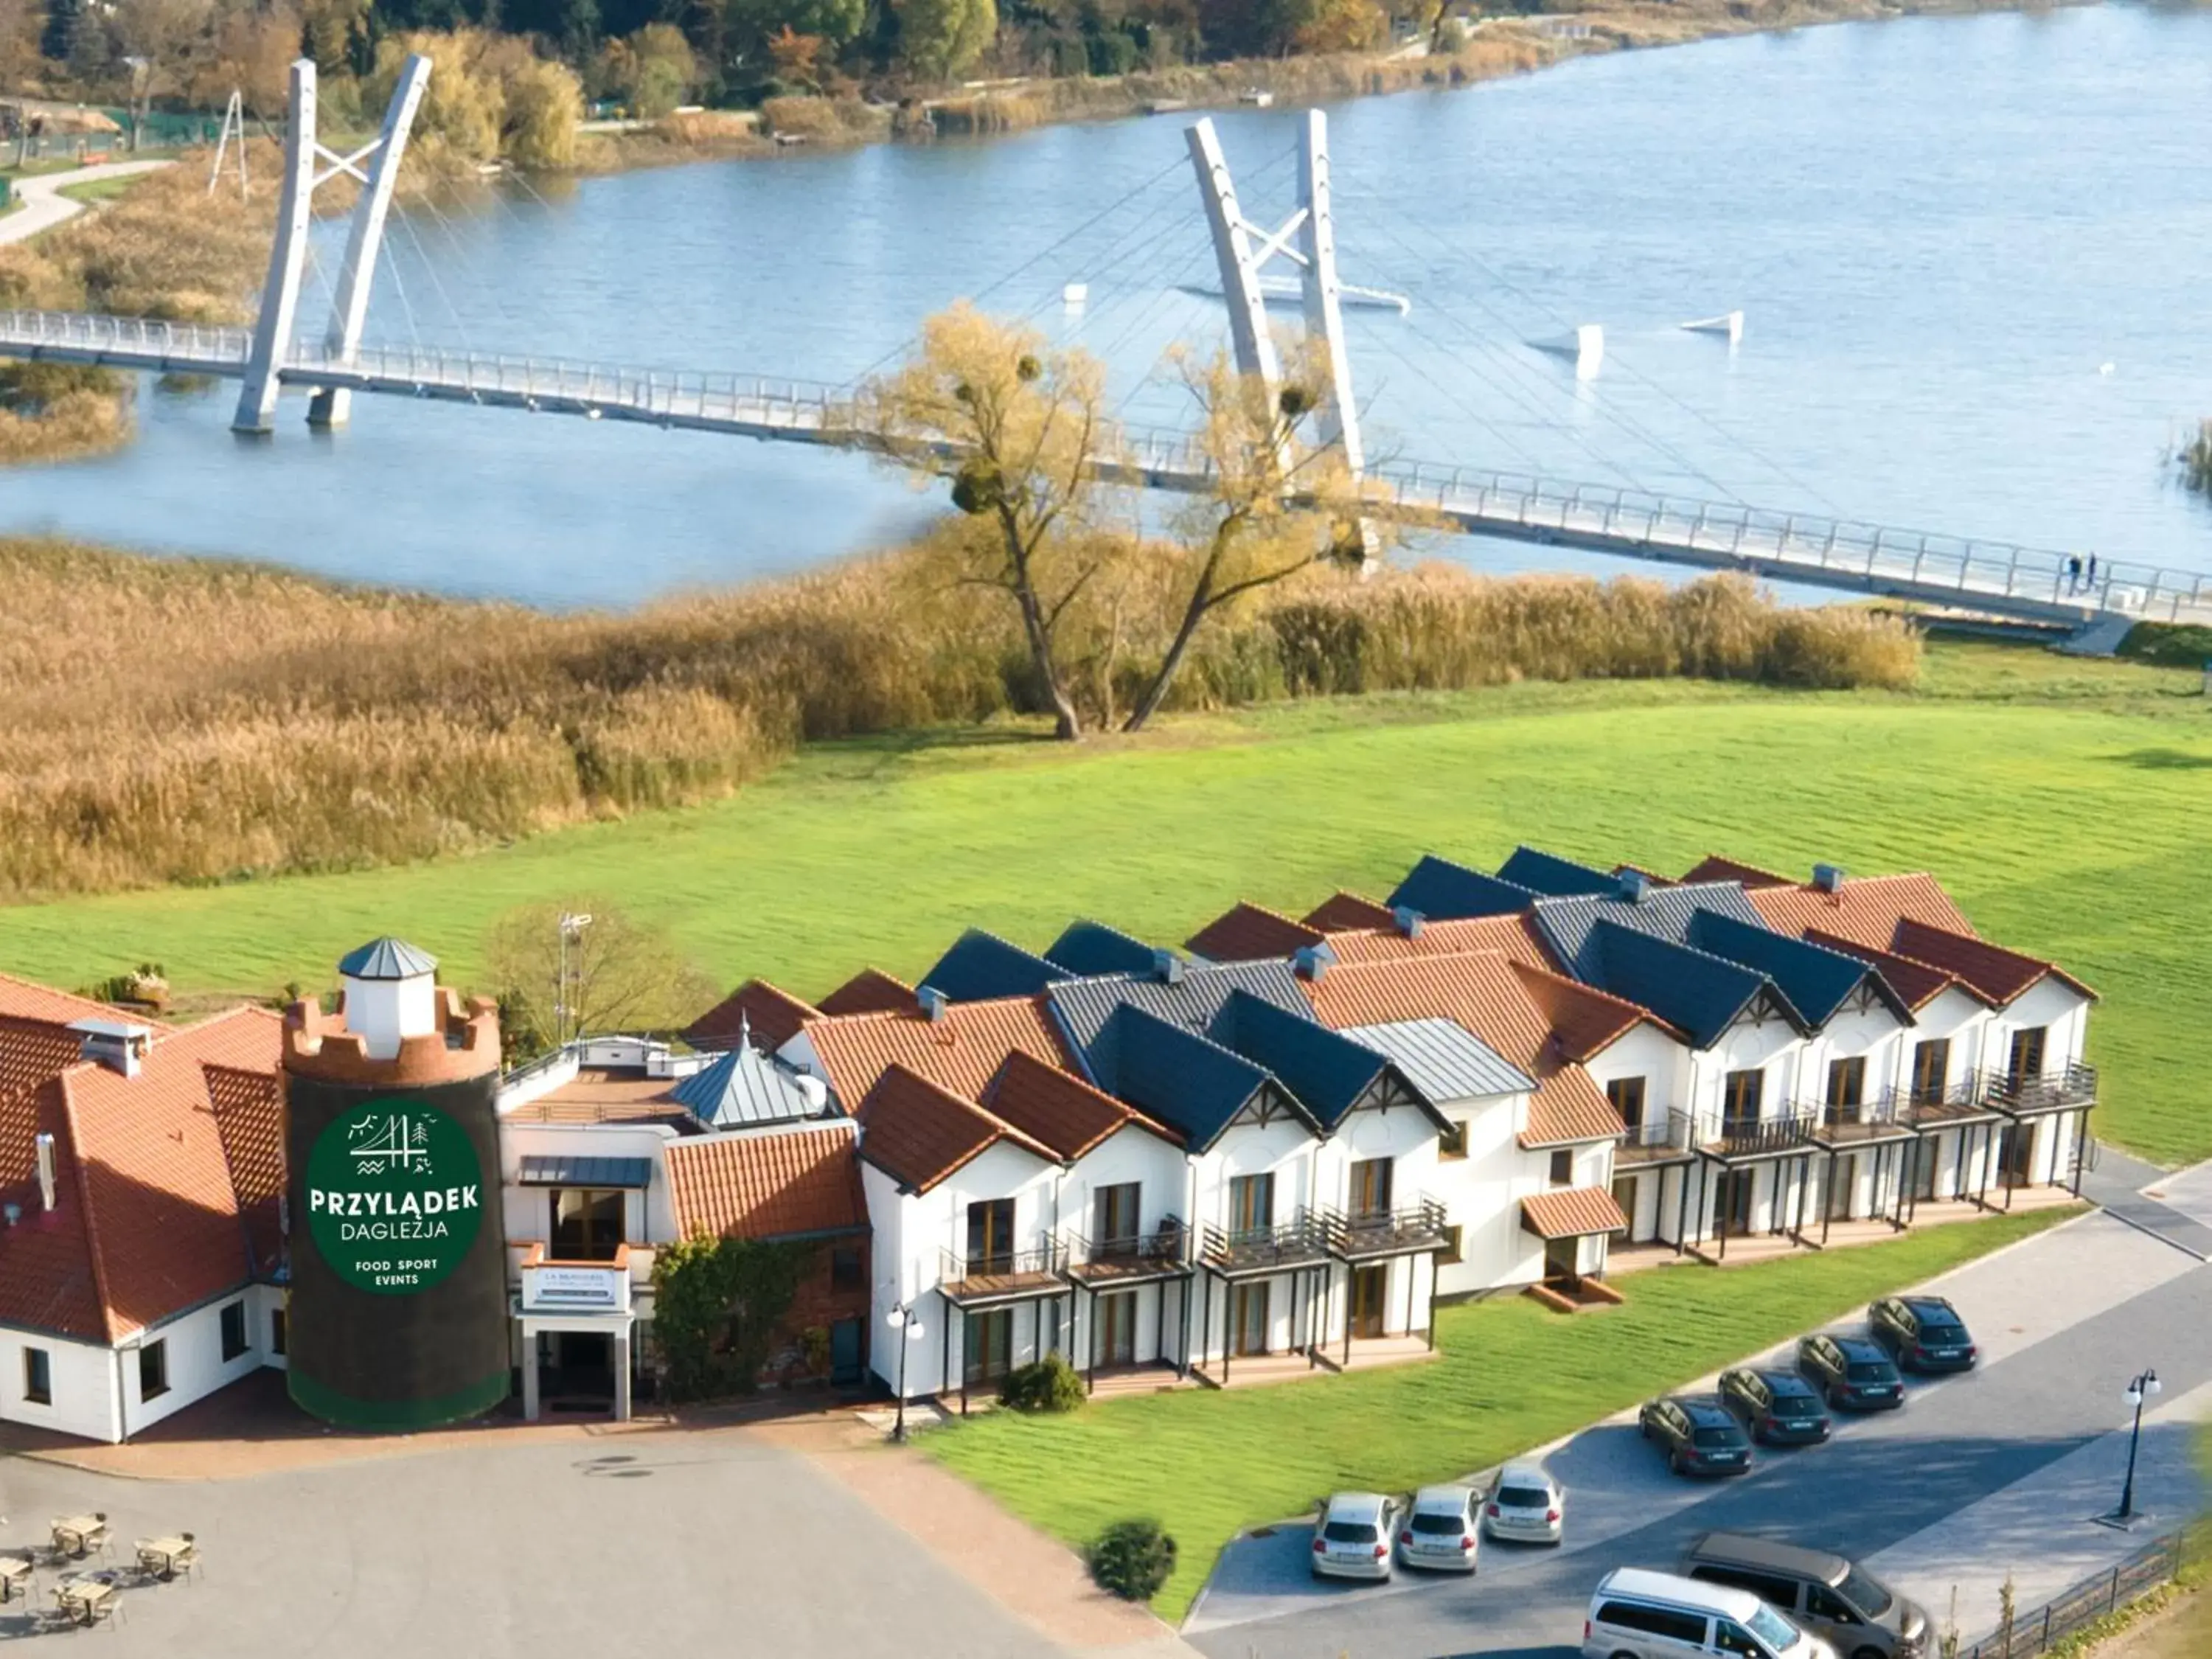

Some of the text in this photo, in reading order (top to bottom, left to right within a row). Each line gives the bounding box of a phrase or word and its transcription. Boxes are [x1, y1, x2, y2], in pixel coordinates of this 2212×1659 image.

[310, 1184, 479, 1220] PRZYLĄDEK
[341, 1221, 449, 1240] DAGLEZJA
[356, 1259, 437, 1271] FOOD SPORT
[375, 1274, 419, 1286] EVENTS
